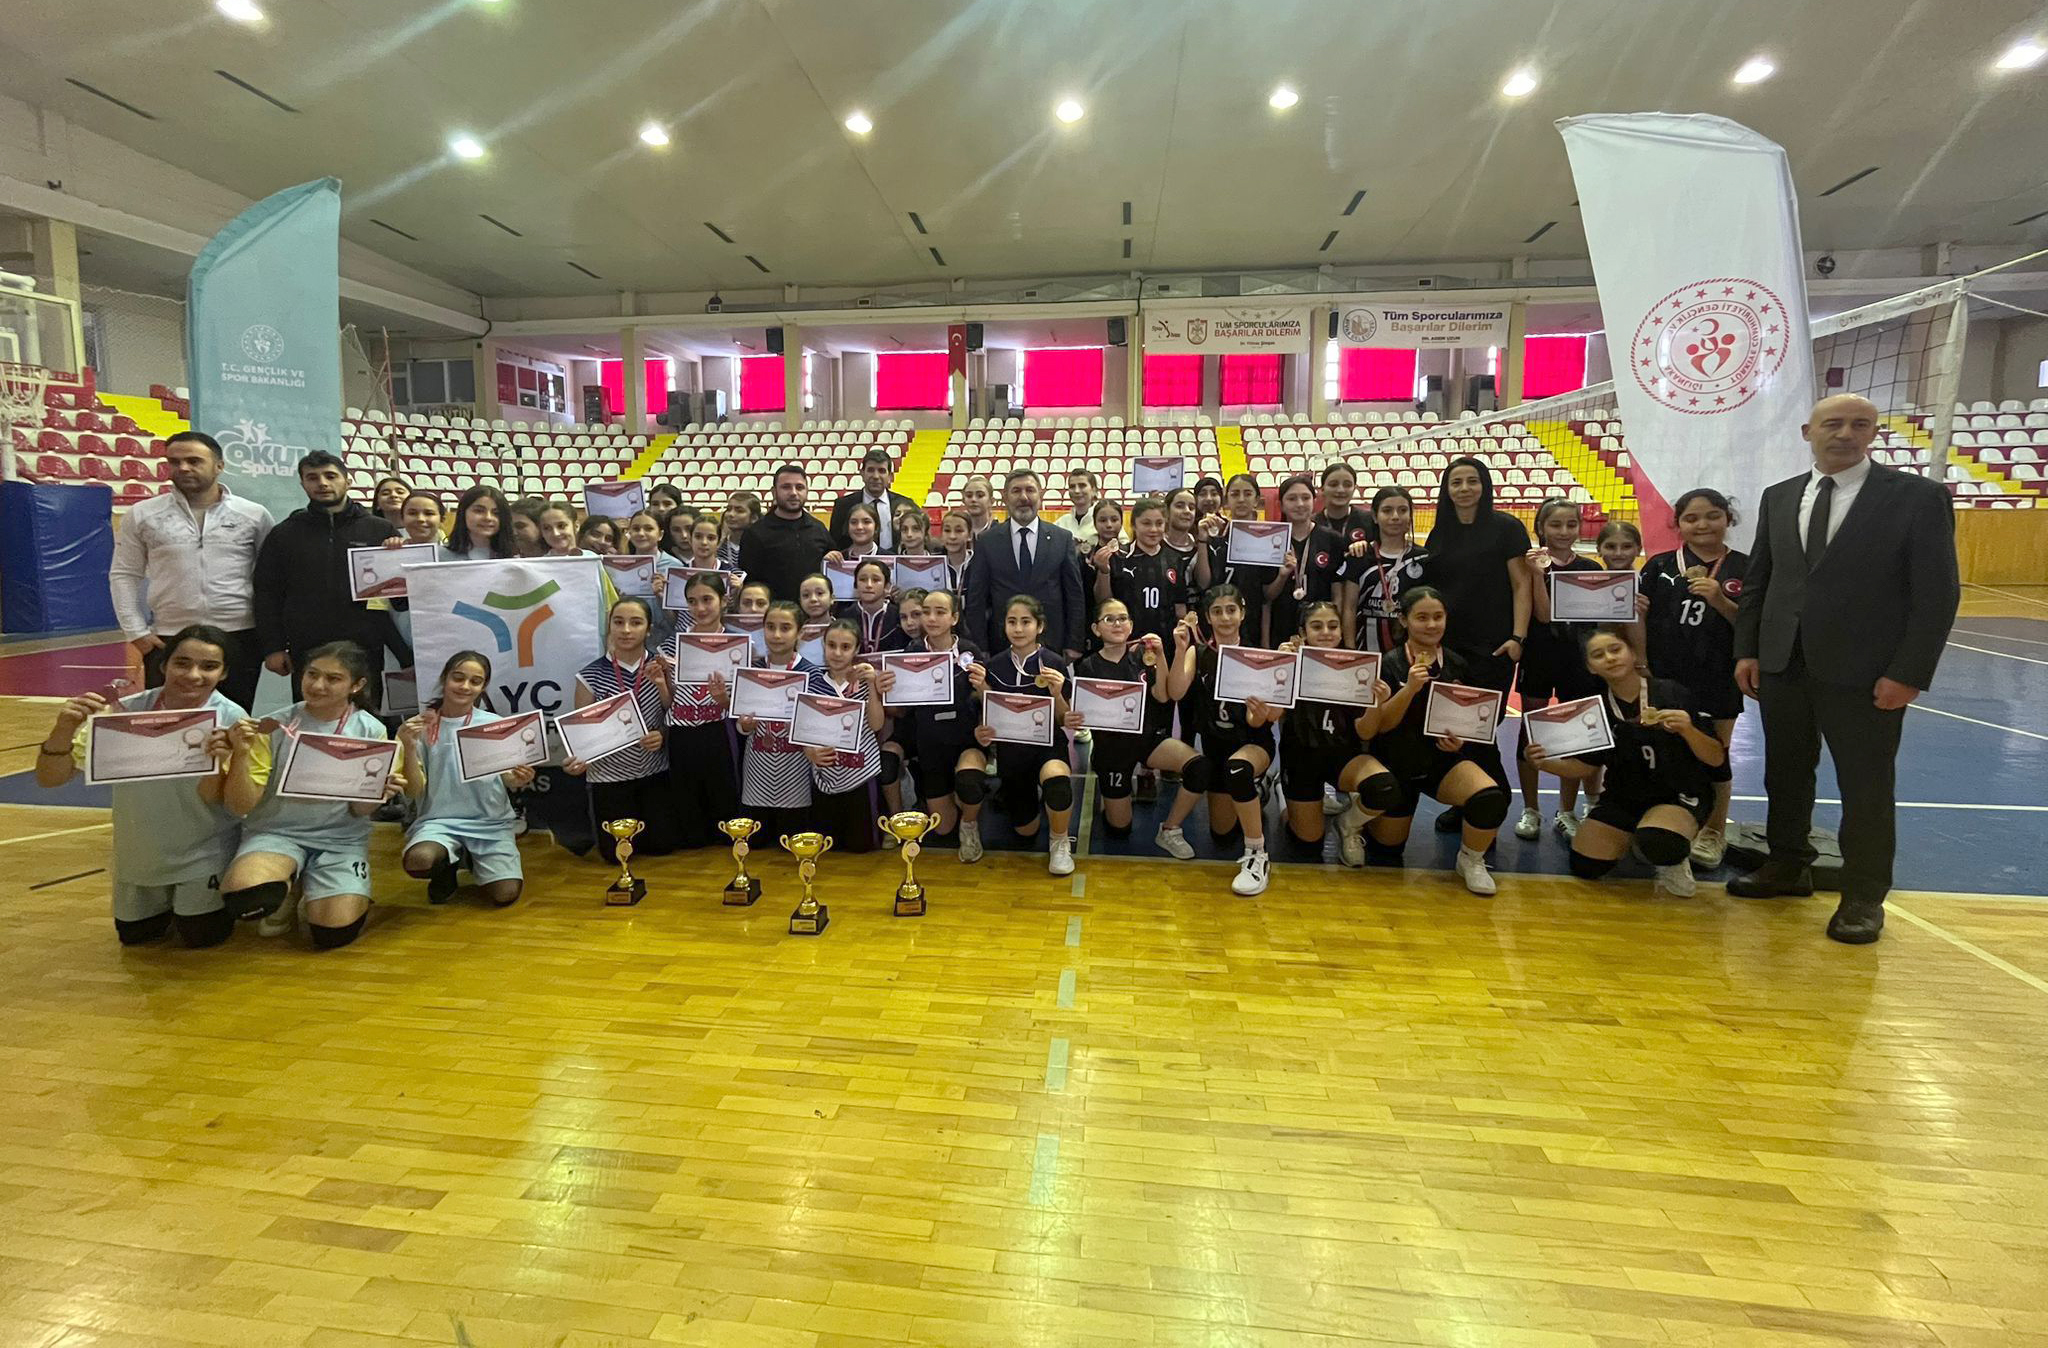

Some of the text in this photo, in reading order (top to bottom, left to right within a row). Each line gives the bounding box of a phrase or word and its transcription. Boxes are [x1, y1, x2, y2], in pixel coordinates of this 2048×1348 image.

[1383, 311, 1503, 322] Tüm Sporcularımıza
[1215, 320, 1301, 329] TÜM SPORCULARIMIZA
[1391, 322, 1492, 333] Başarılar Dilerim
[1214, 328, 1301, 338] BAŞARILAR DİLERİM
[222, 372, 248, 383] SPOR
[291, 369, 305, 378] VE
[1224, 566, 1235, 584] 7
[1142, 587, 1159, 609] 10
[1679, 599, 1706, 626] 13
[1322, 709, 1336, 735] 4
[1641, 745, 1656, 769] 9
[1109, 772, 1122, 787] 12
[352, 861, 367, 879] 13
